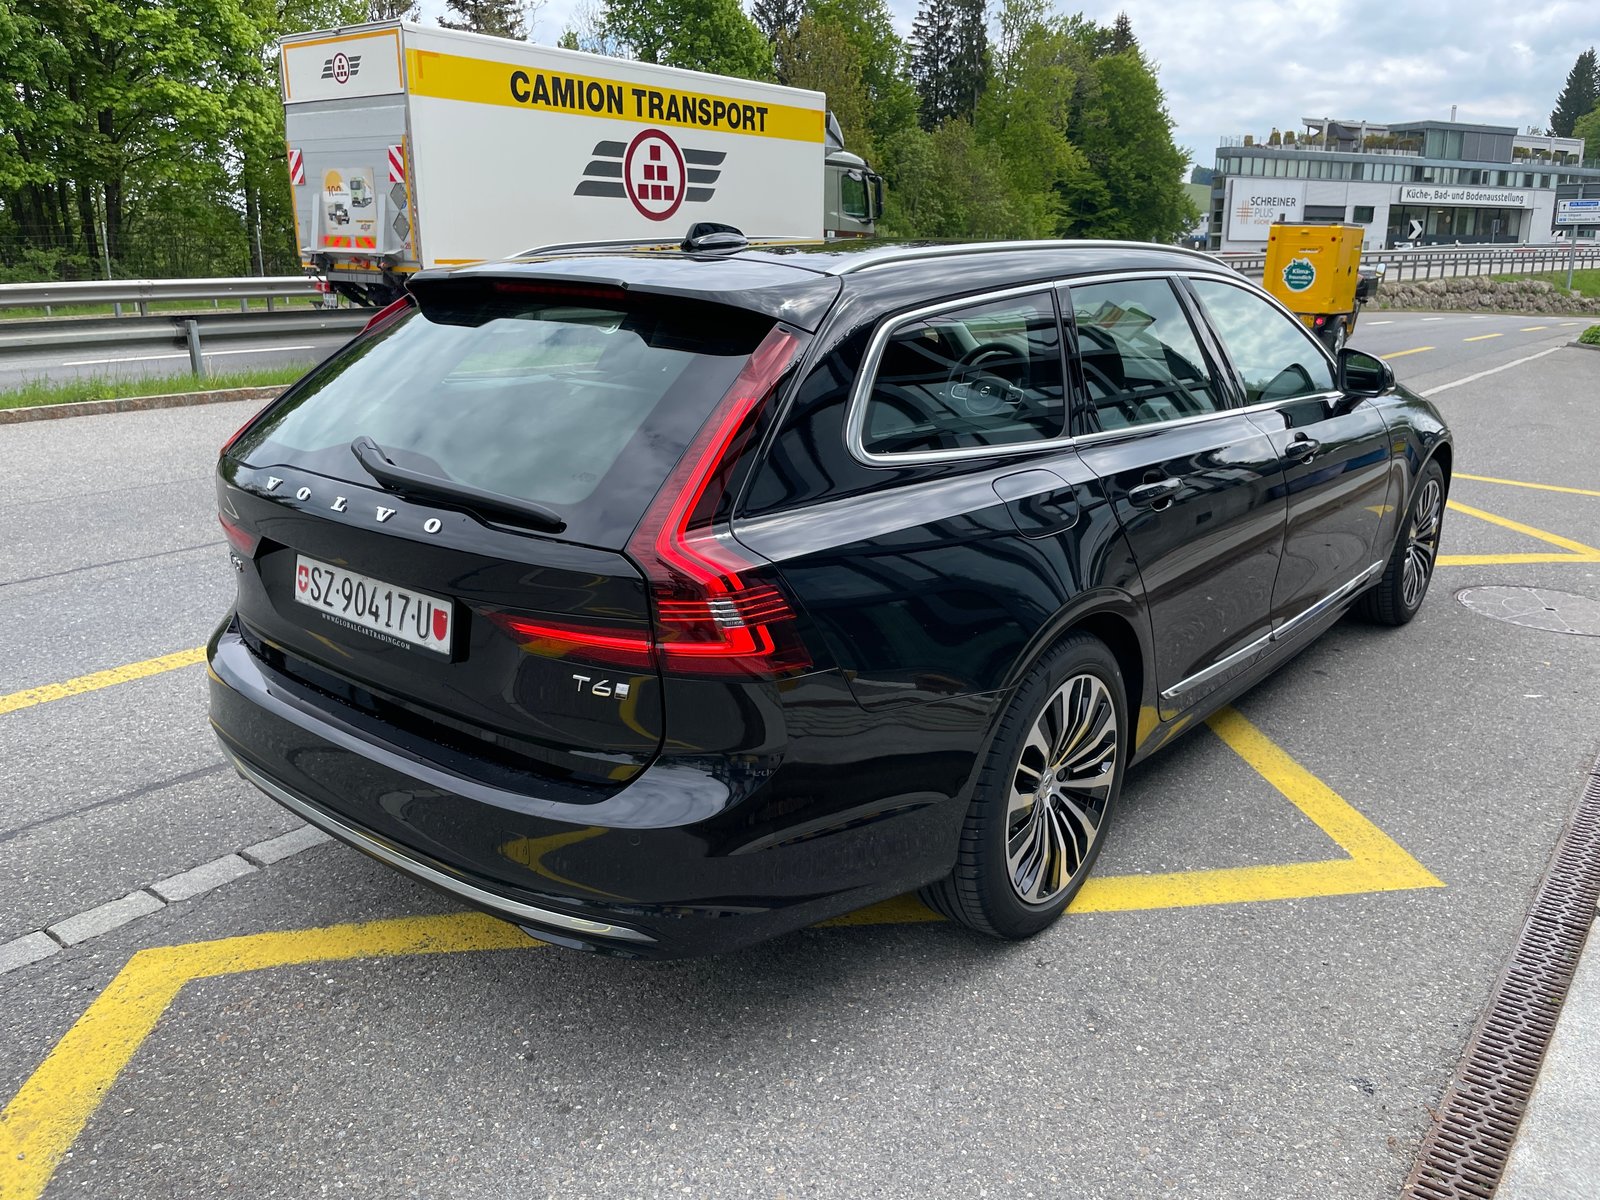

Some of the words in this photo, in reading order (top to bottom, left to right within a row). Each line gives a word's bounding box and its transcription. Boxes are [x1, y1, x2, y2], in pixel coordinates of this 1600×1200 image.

[510, 70, 624, 115] CAMION
[631, 88, 769, 132] TRANSPORT
[1250, 196, 1296, 207] SCHREINER
[1434, 190, 1450, 200] Bad-
[1452, 191, 1465, 200] und
[1466, 191, 1524, 204] Bodenausstellung
[1254, 208, 1274, 218] PLUS
[266, 476, 443, 534] VOLVO
[572, 674, 612, 697] T6
